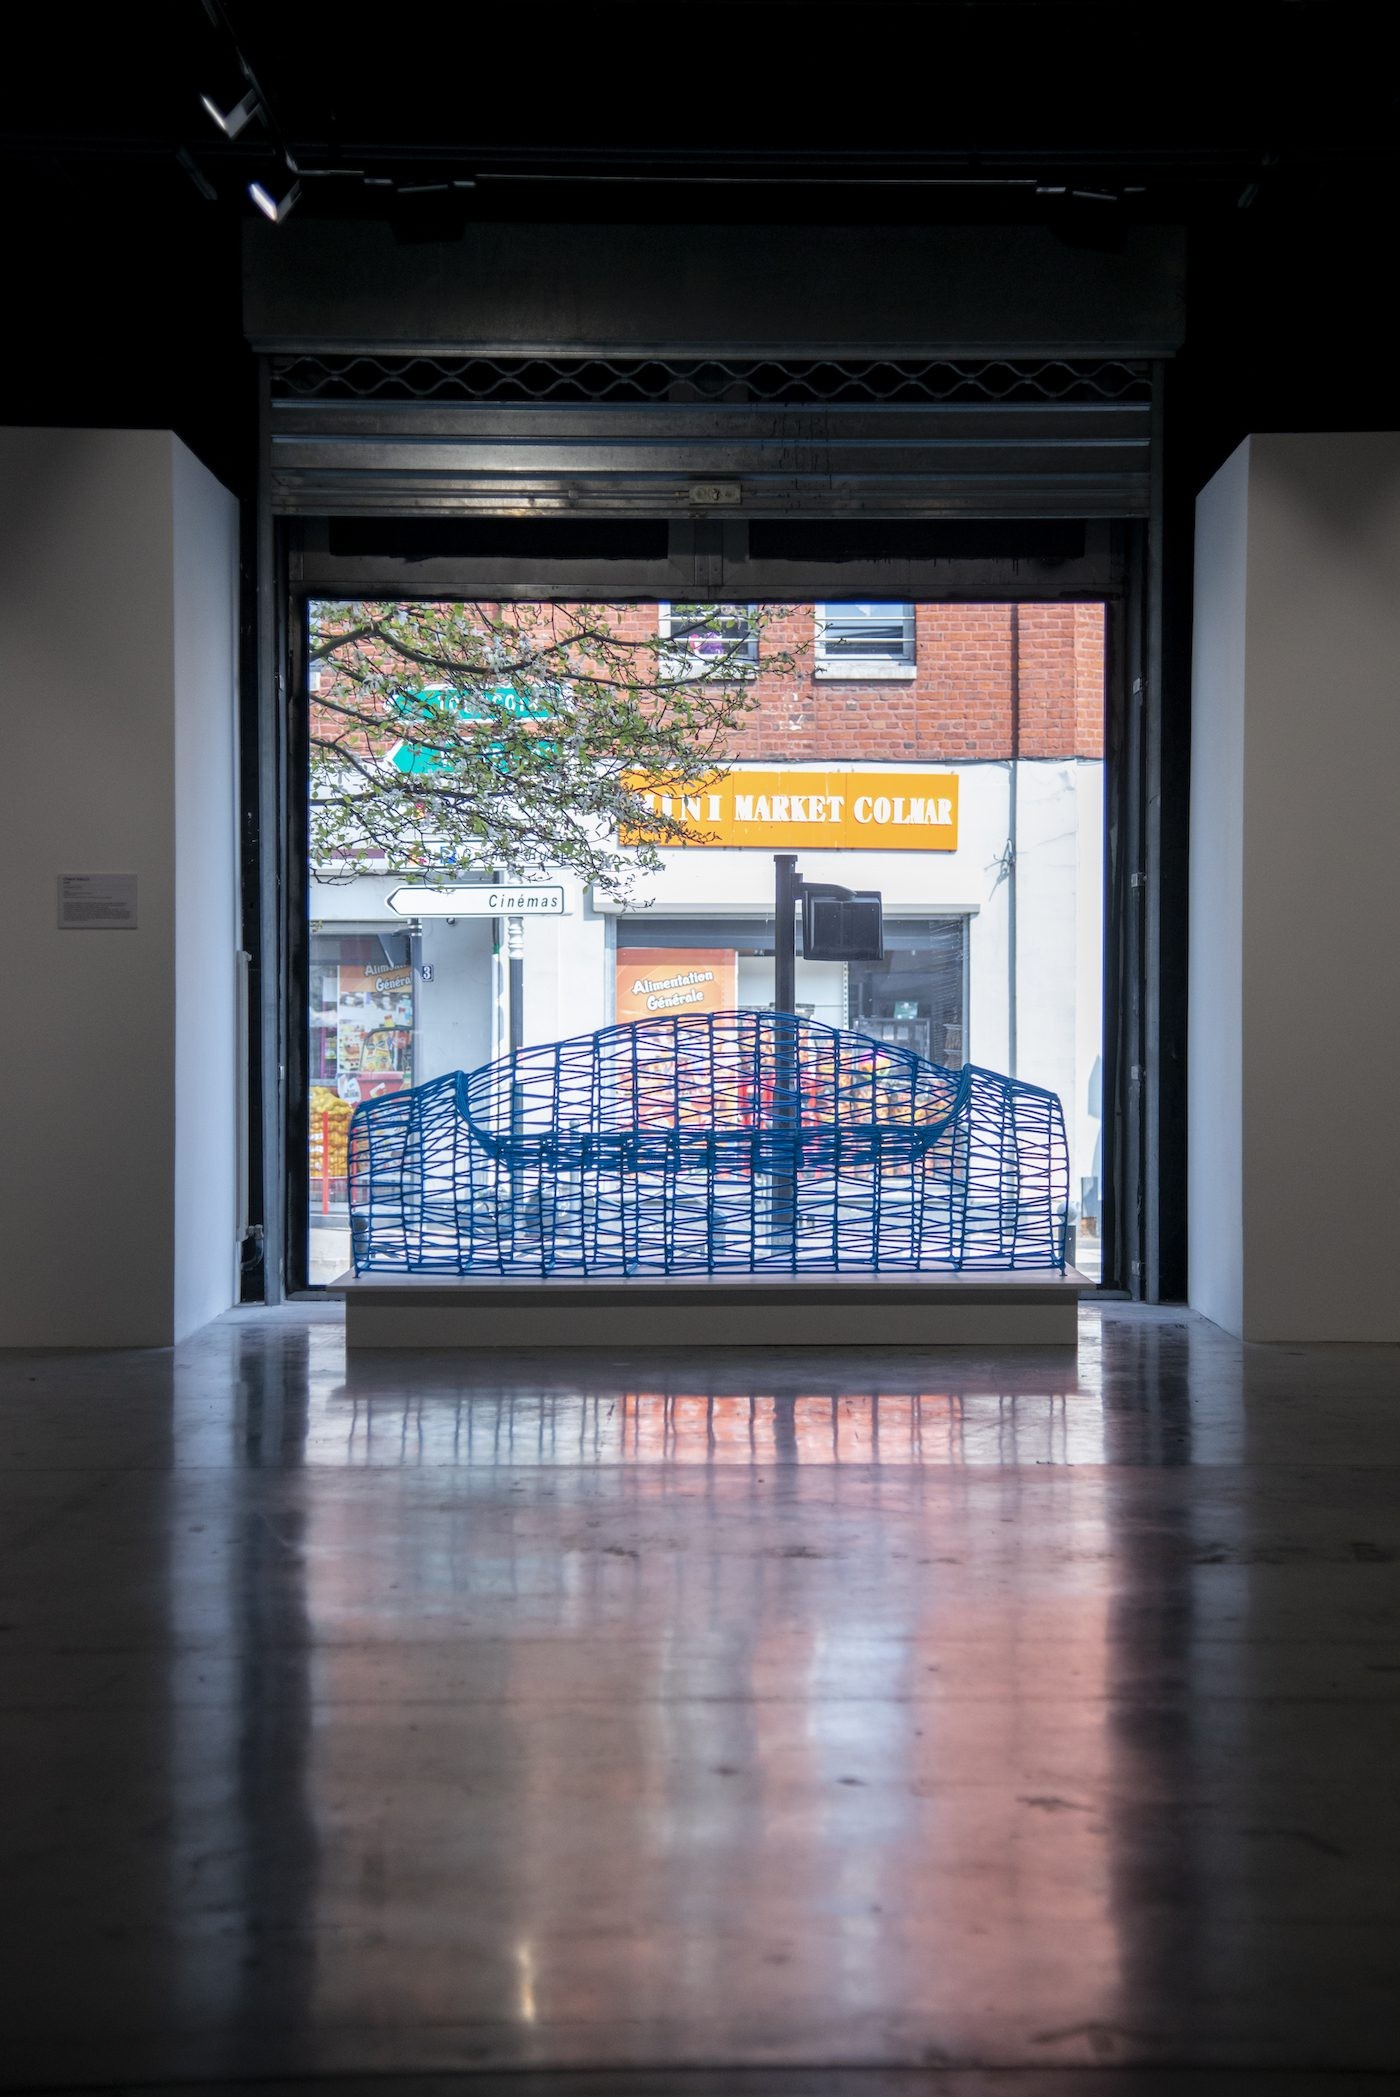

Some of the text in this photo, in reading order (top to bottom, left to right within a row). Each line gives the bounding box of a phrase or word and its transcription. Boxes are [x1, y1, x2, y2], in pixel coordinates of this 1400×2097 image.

[733, 794, 844, 823] MARKET
[853, 796, 953, 825] COLMAR
[489, 894, 558, 908] Cinémas
[423, 966, 431, 980] 3
[631, 970, 714, 995] Alimentation
[646, 988, 704, 1011] Générale
